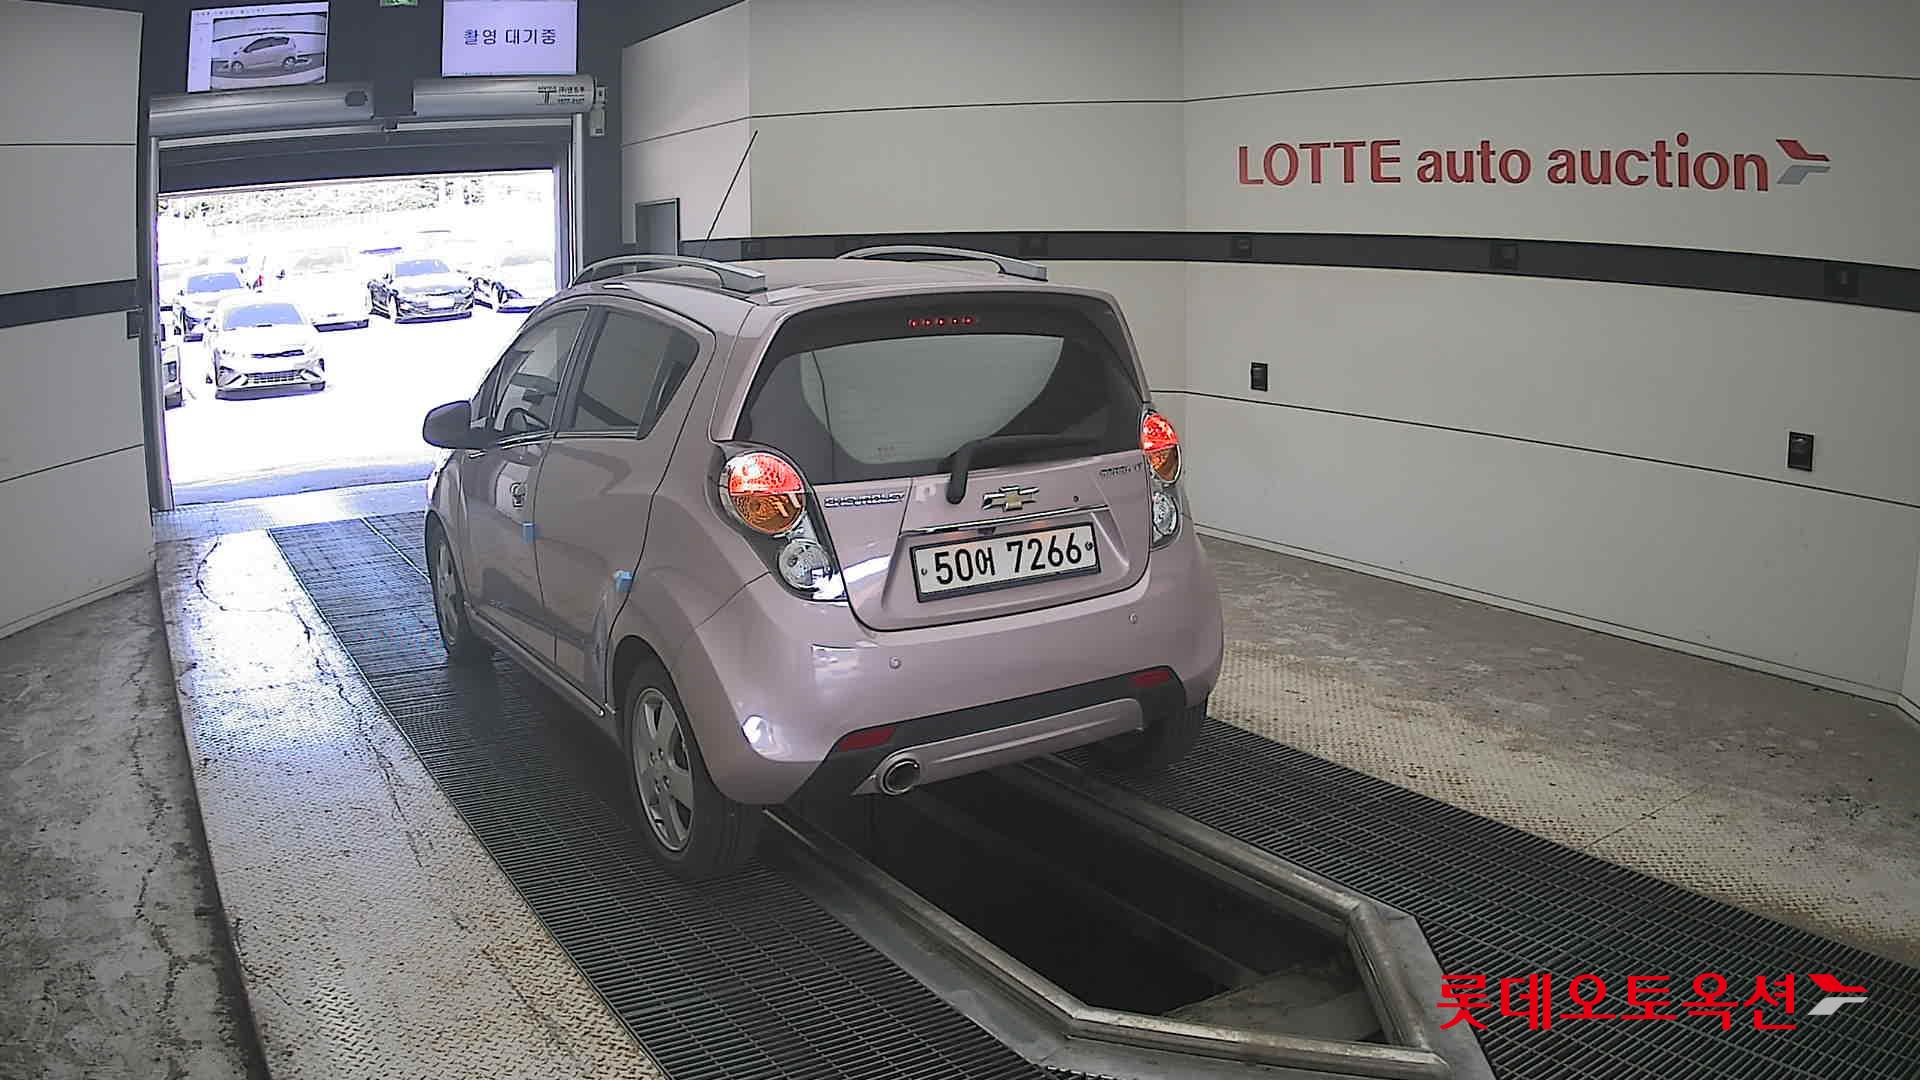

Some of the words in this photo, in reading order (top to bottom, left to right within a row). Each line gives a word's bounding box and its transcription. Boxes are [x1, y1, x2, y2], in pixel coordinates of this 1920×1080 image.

[463, 28, 497, 46] 촬영
[504, 28, 557, 46] 대기중
[1238, 140, 1401, 186] LOTTE
[1416, 140, 1532, 184] auto
[1547, 132, 1769, 192] auction
[934, 546, 996, 585] 50어
[1005, 532, 1083, 574] 7266
